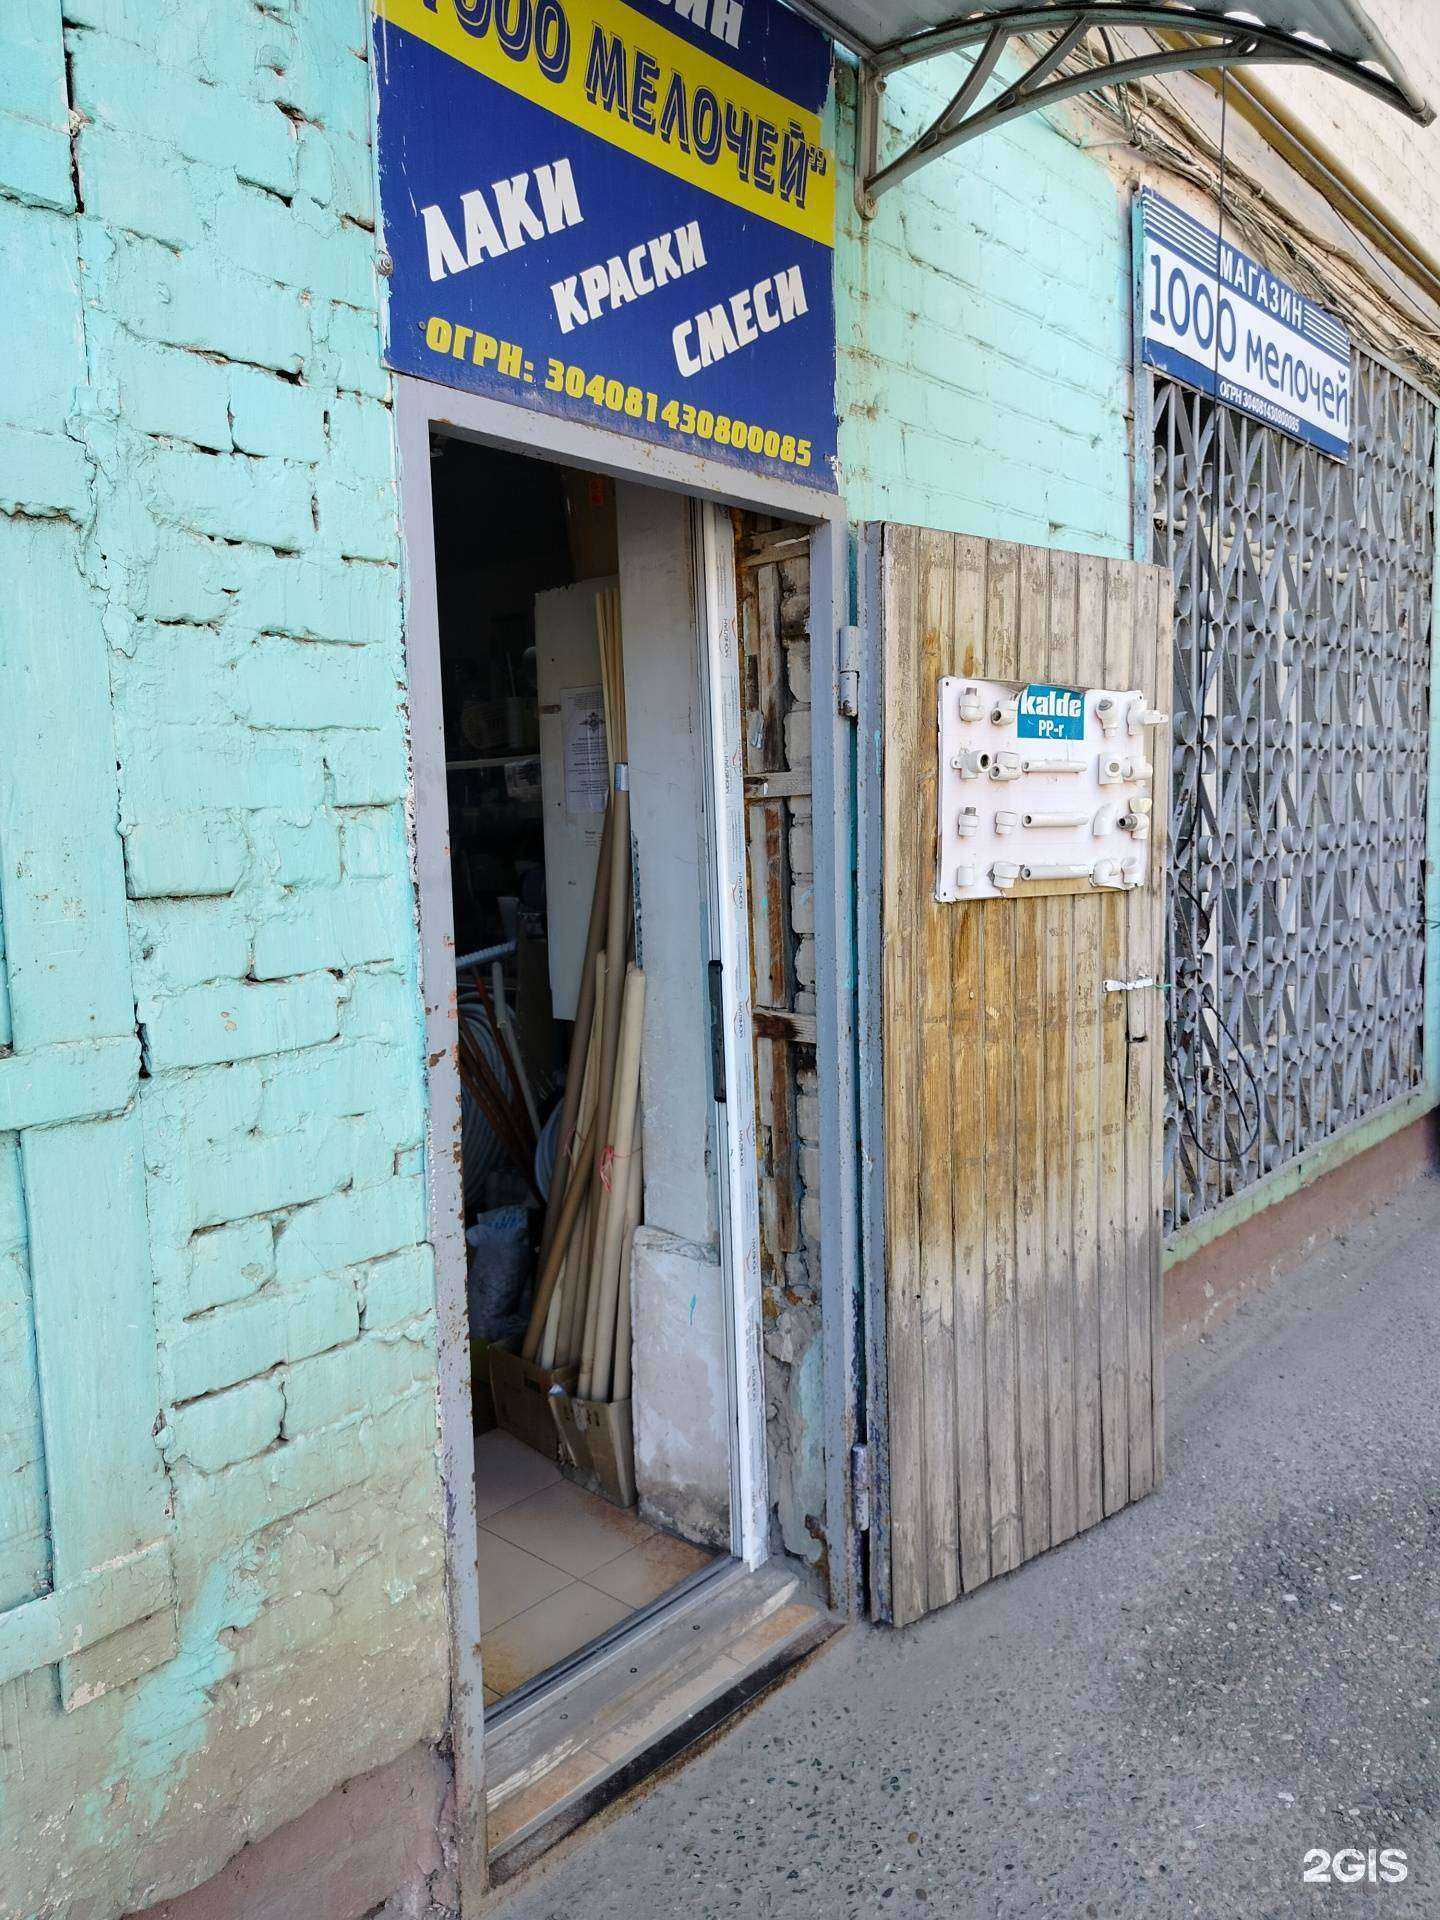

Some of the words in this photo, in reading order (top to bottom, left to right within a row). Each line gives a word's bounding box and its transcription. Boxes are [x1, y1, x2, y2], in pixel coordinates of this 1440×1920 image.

[421, 158, 584, 282] ЛАКИ
[550, 220, 707, 334] КРАСКИ
[671, 264, 809, 378] СМЕСИ
[1151, 254, 1236, 362] 1000
[1247, 330, 1348, 426] мелочей
[1219, 246, 1303, 330] МАГАЗИН
[425, 316, 534, 382] ОГРН:
[545, 358, 812, 468] 304081430800085
[1021, 691, 1082, 717] kalde
[1039, 720, 1064, 737] PP-r
